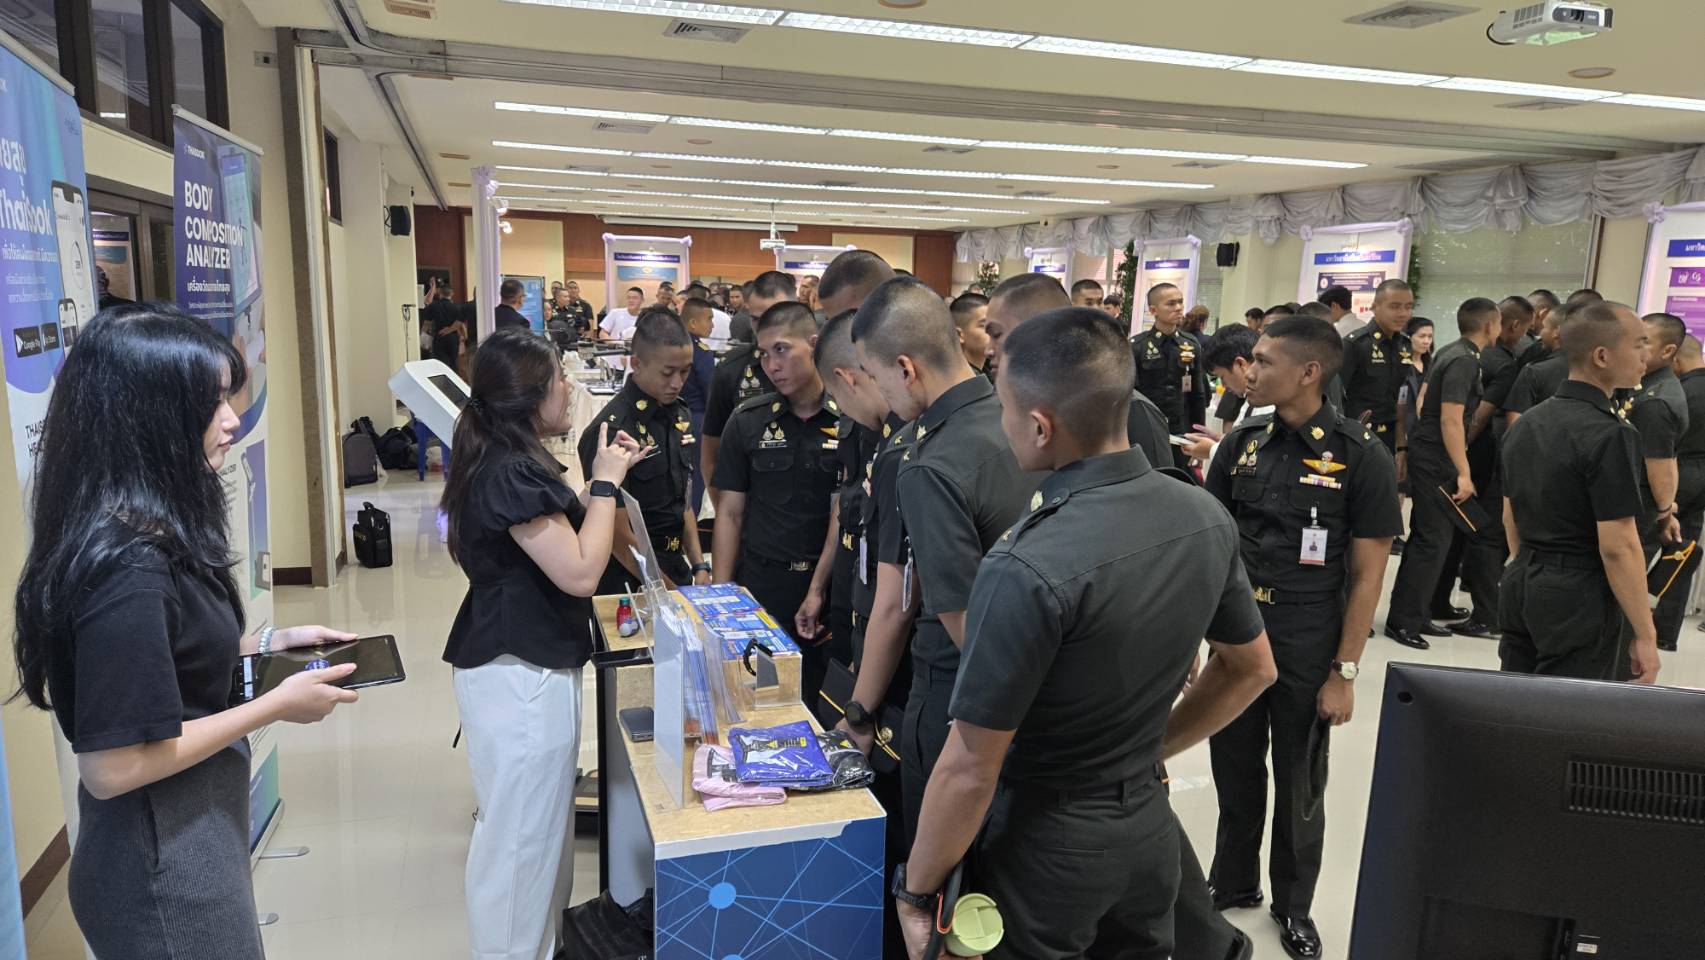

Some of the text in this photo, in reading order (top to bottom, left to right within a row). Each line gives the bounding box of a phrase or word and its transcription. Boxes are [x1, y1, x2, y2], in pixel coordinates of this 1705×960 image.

[185, 180, 213, 212] BODY
[185, 216, 244, 246] COMPOSITION
[186, 244, 231, 269] ANALYZER
